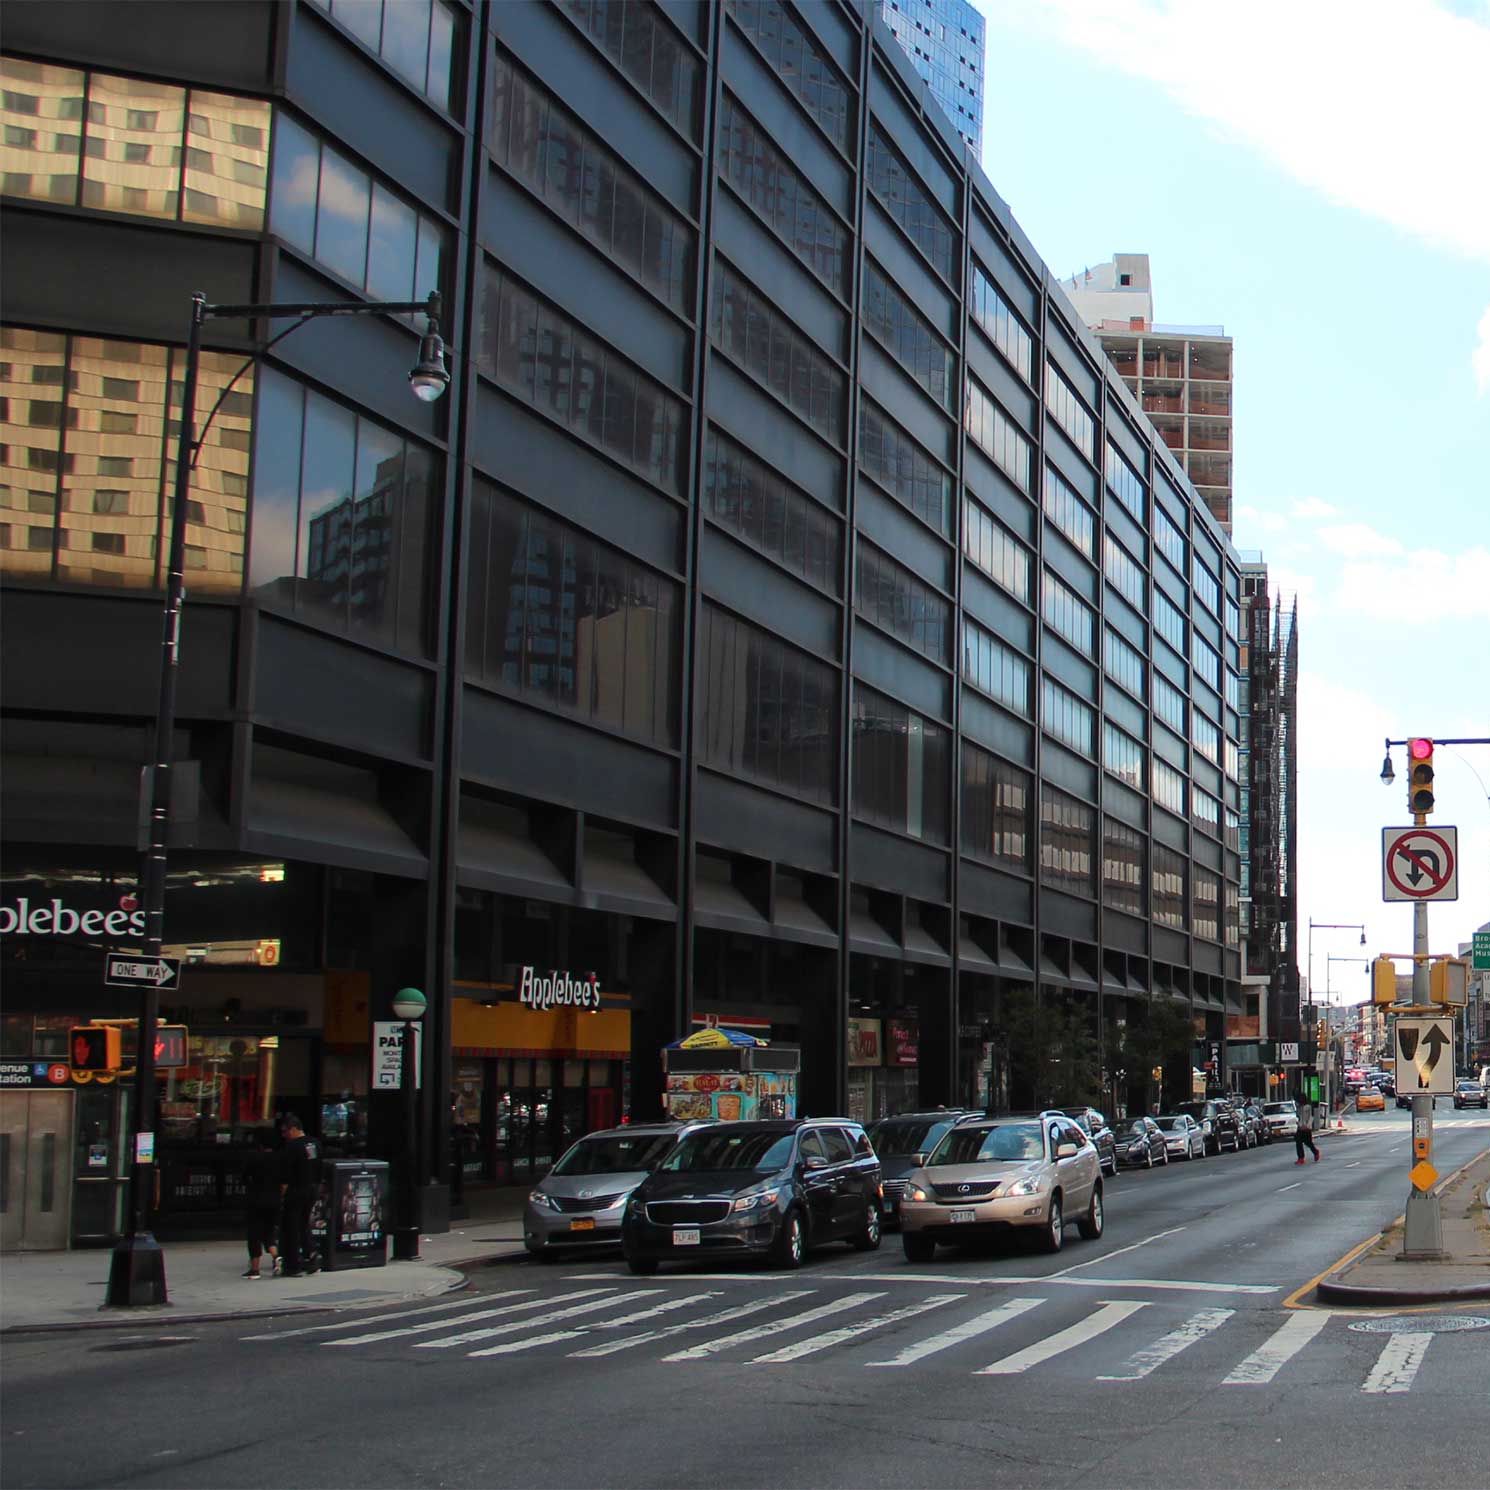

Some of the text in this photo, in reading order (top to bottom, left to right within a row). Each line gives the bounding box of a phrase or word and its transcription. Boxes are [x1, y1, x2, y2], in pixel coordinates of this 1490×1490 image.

[117, 963, 168, 979] ONE WAY
[520, 966, 600, 1010] Applebee's
[0, 1063, 28, 1073] enue
[54, 1069, 65, 1080] B
